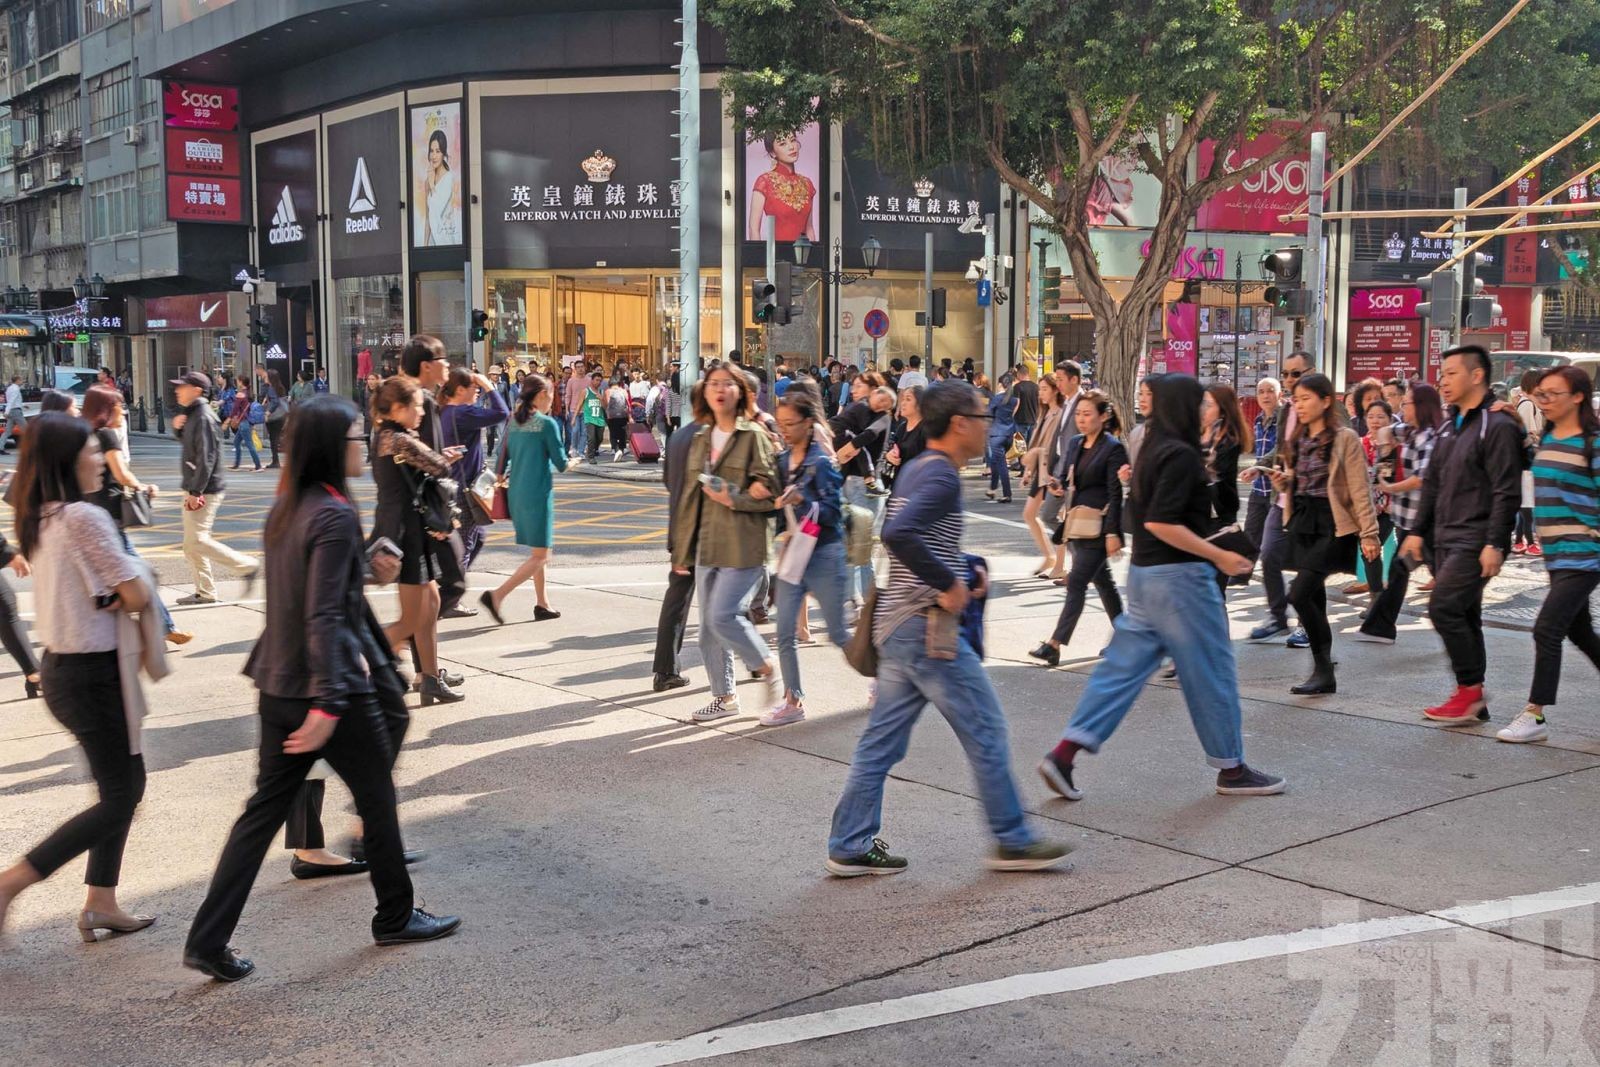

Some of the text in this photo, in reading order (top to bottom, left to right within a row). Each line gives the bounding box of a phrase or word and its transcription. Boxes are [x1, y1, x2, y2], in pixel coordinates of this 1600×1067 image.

[187, 150, 221, 158] OUTLETS
[185, 191, 226, 206] 特賣場
[866, 196, 980, 215] 英皇鐘錶珠寶
[504, 208, 681, 221] EMPEROR WATCH AND JEWELLE
[861, 213, 896, 222] EMPEROR
[898, 215, 925, 223] WATCH
[925, 216, 941, 224] AND
[345, 214, 380, 233] Reebok
[269, 223, 303, 245] adidas
[1411, 250, 1440, 260] Emperor
[1368, 293, 1404, 309] Sasa
[101, 316, 121, 328] 名店
[1168, 339, 1193, 351] Sasa
[591, 406, 600, 417] 11
